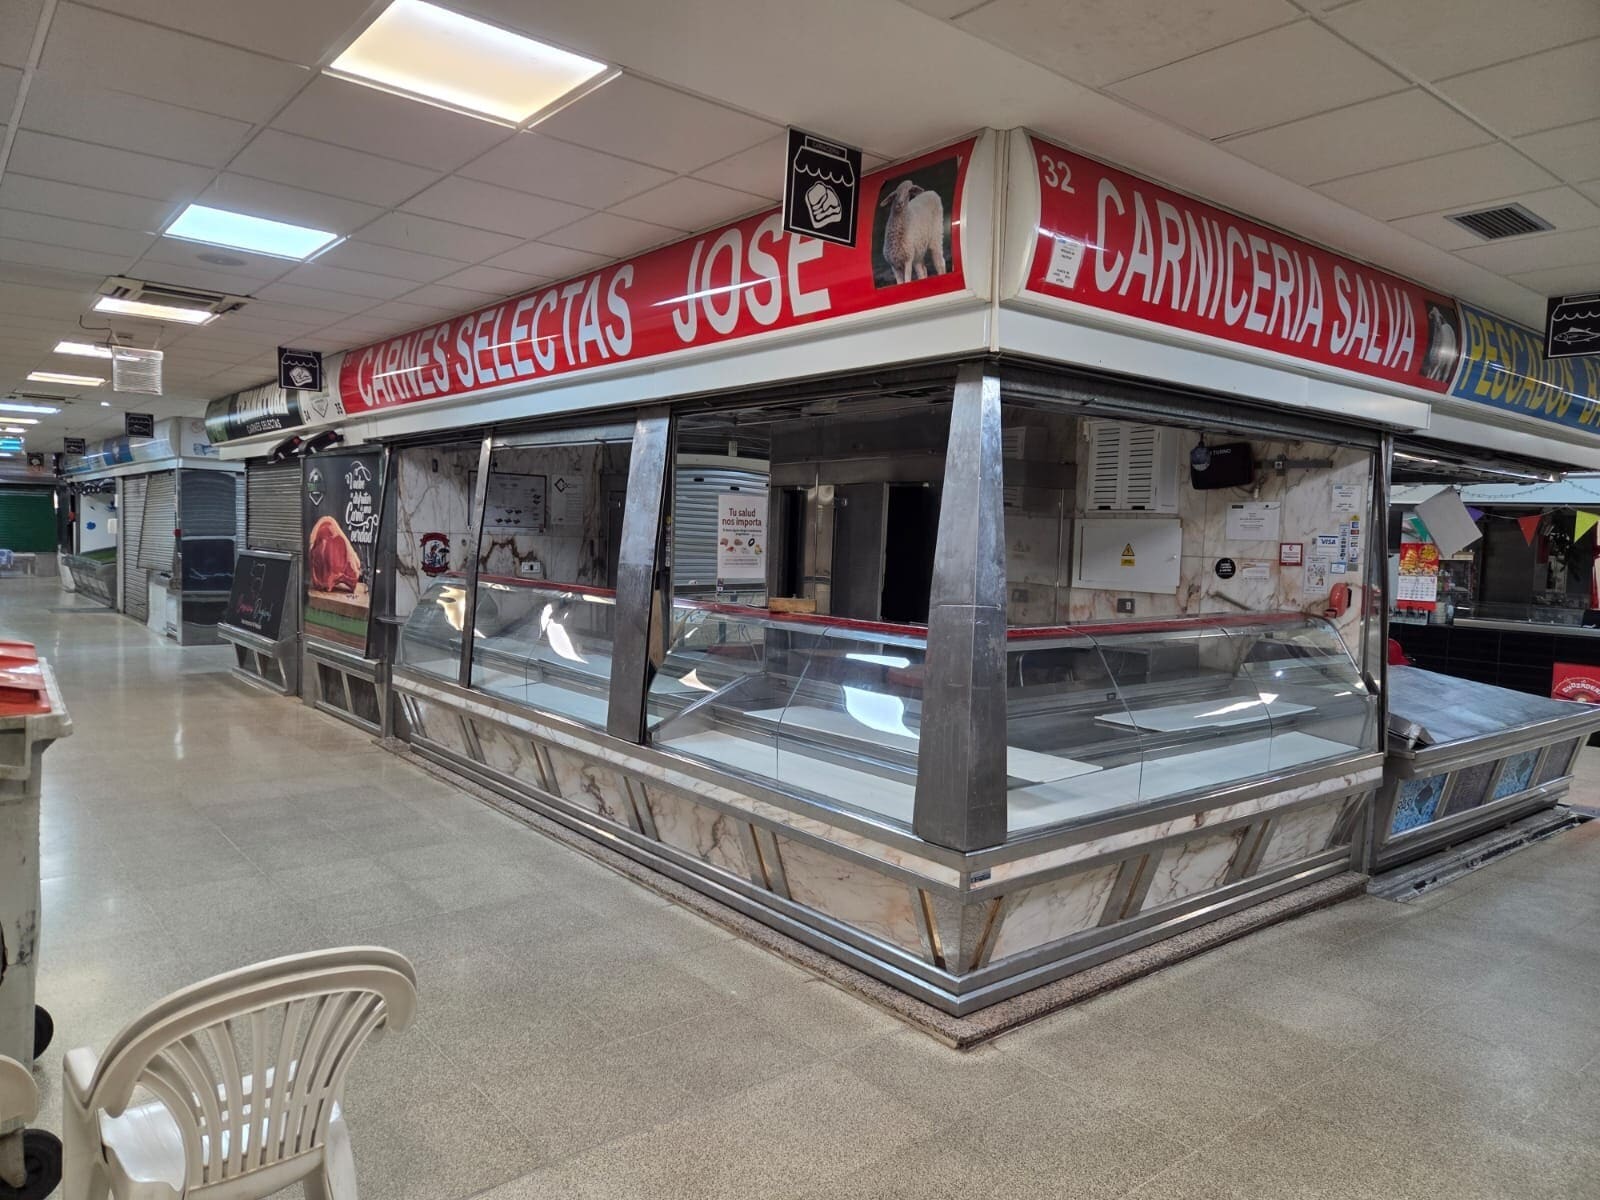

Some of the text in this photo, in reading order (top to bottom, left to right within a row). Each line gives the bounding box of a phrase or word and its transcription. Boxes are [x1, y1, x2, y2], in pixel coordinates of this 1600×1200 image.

[1041, 154, 1075, 195] 32
[1094, 177, 1417, 372] CARNICERIA SALVA
[357, 323, 451, 407] CARNES
[455, 264, 635, 388] SELECTAS
[722, 517, 762, 528] nos importa
[728, 507, 756, 517] Tu salud
